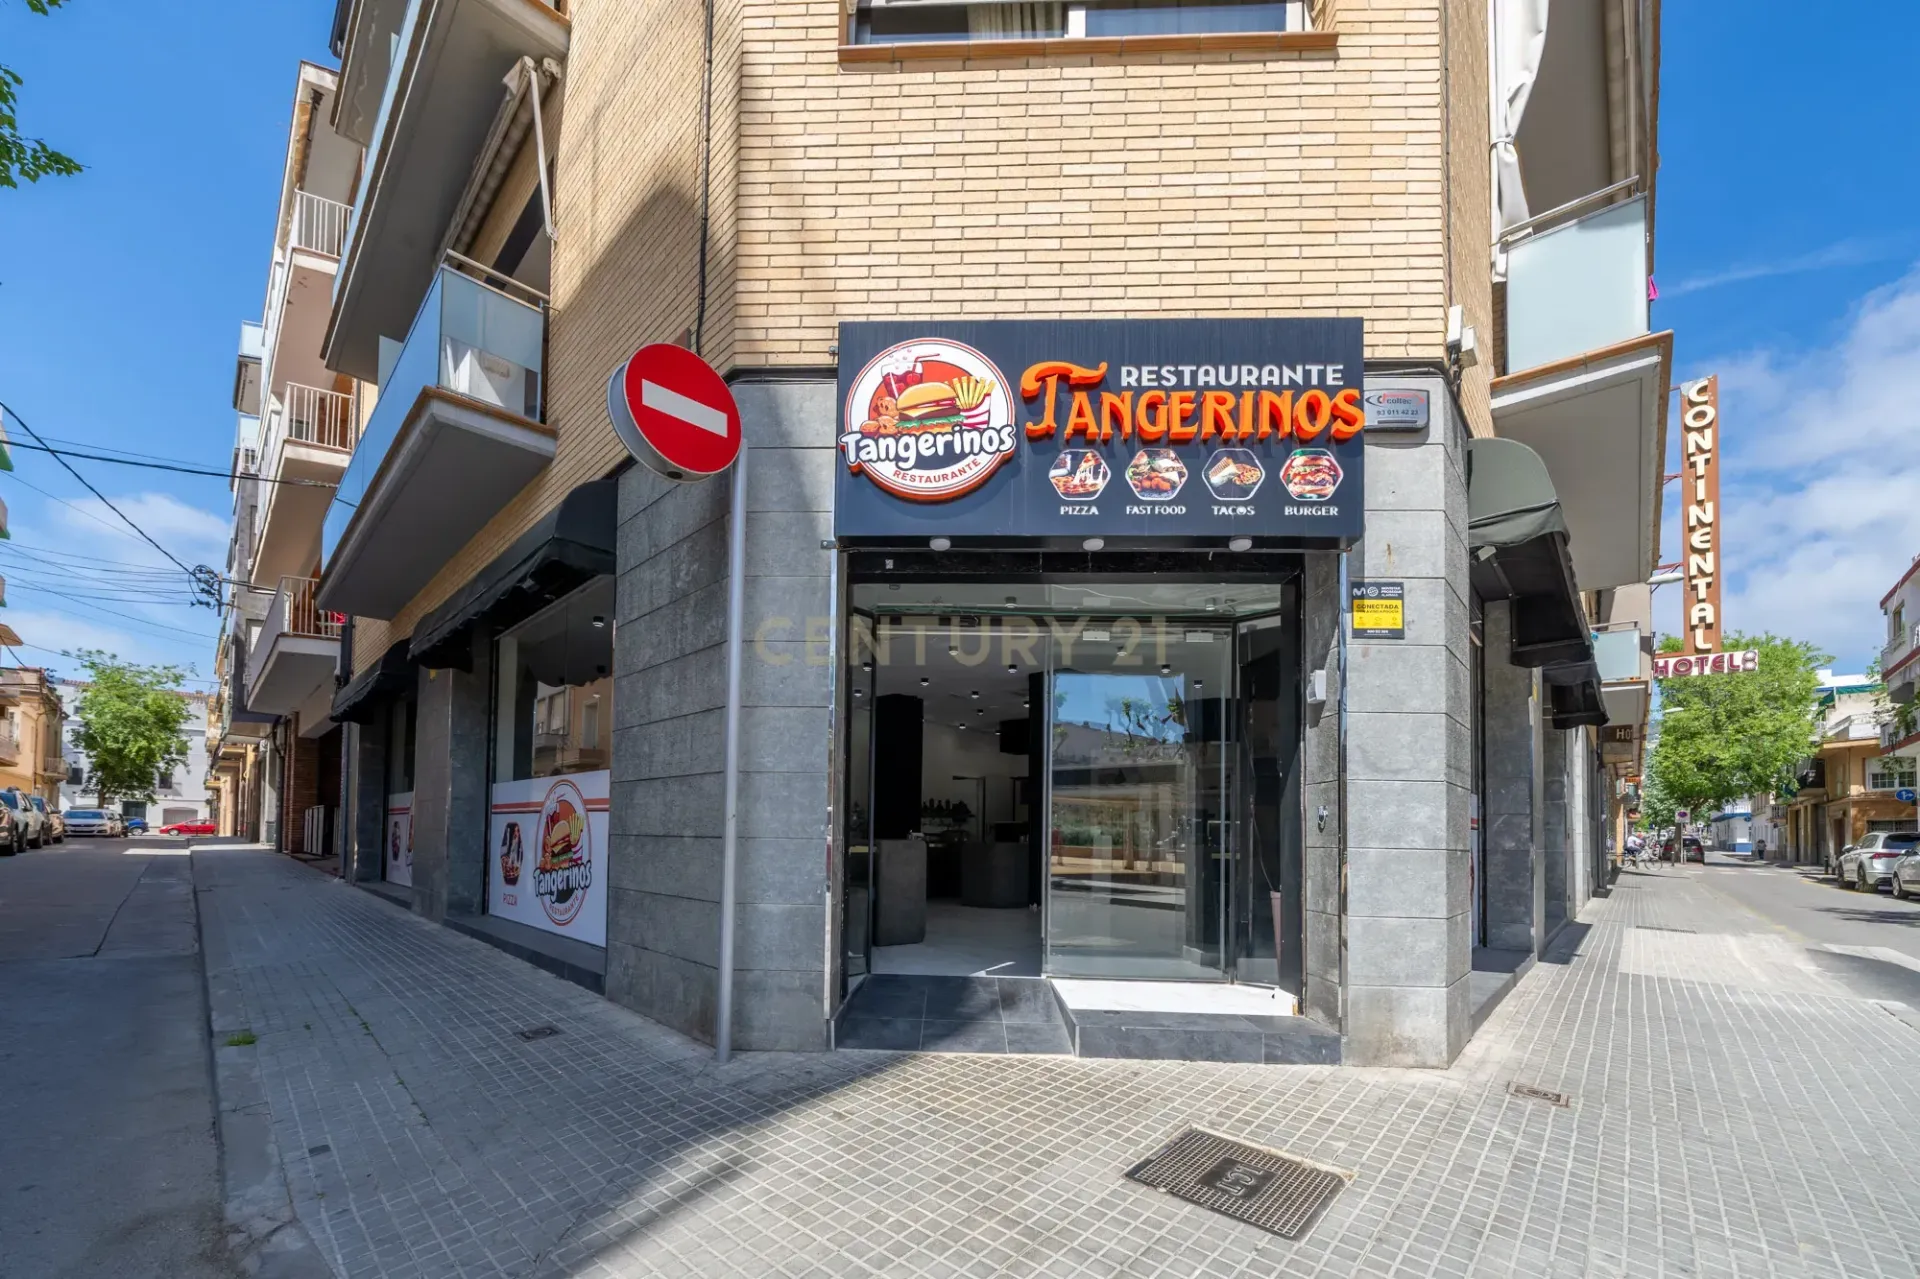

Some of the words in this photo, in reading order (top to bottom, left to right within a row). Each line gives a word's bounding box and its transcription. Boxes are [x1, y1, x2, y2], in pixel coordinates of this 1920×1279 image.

[1121, 364, 1344, 387] RESTAURANTE
[1020, 361, 1365, 441] TANGERINOS
[841, 425, 1015, 470] Tangerinos
[893, 458, 982, 484] RESTAURANTE
[1060, 505, 1099, 515] PIZZA
[1126, 505, 1151, 515] FAST
[1154, 505, 1187, 515] FOOD
[1211, 505, 1256, 516] TACOS
[1284, 505, 1339, 516] BURGER
[1685, 380, 1715, 650] CONTINENTAL
[1654, 653, 1741, 677] HOTEL
[533, 860, 592, 904] Tangerinos
